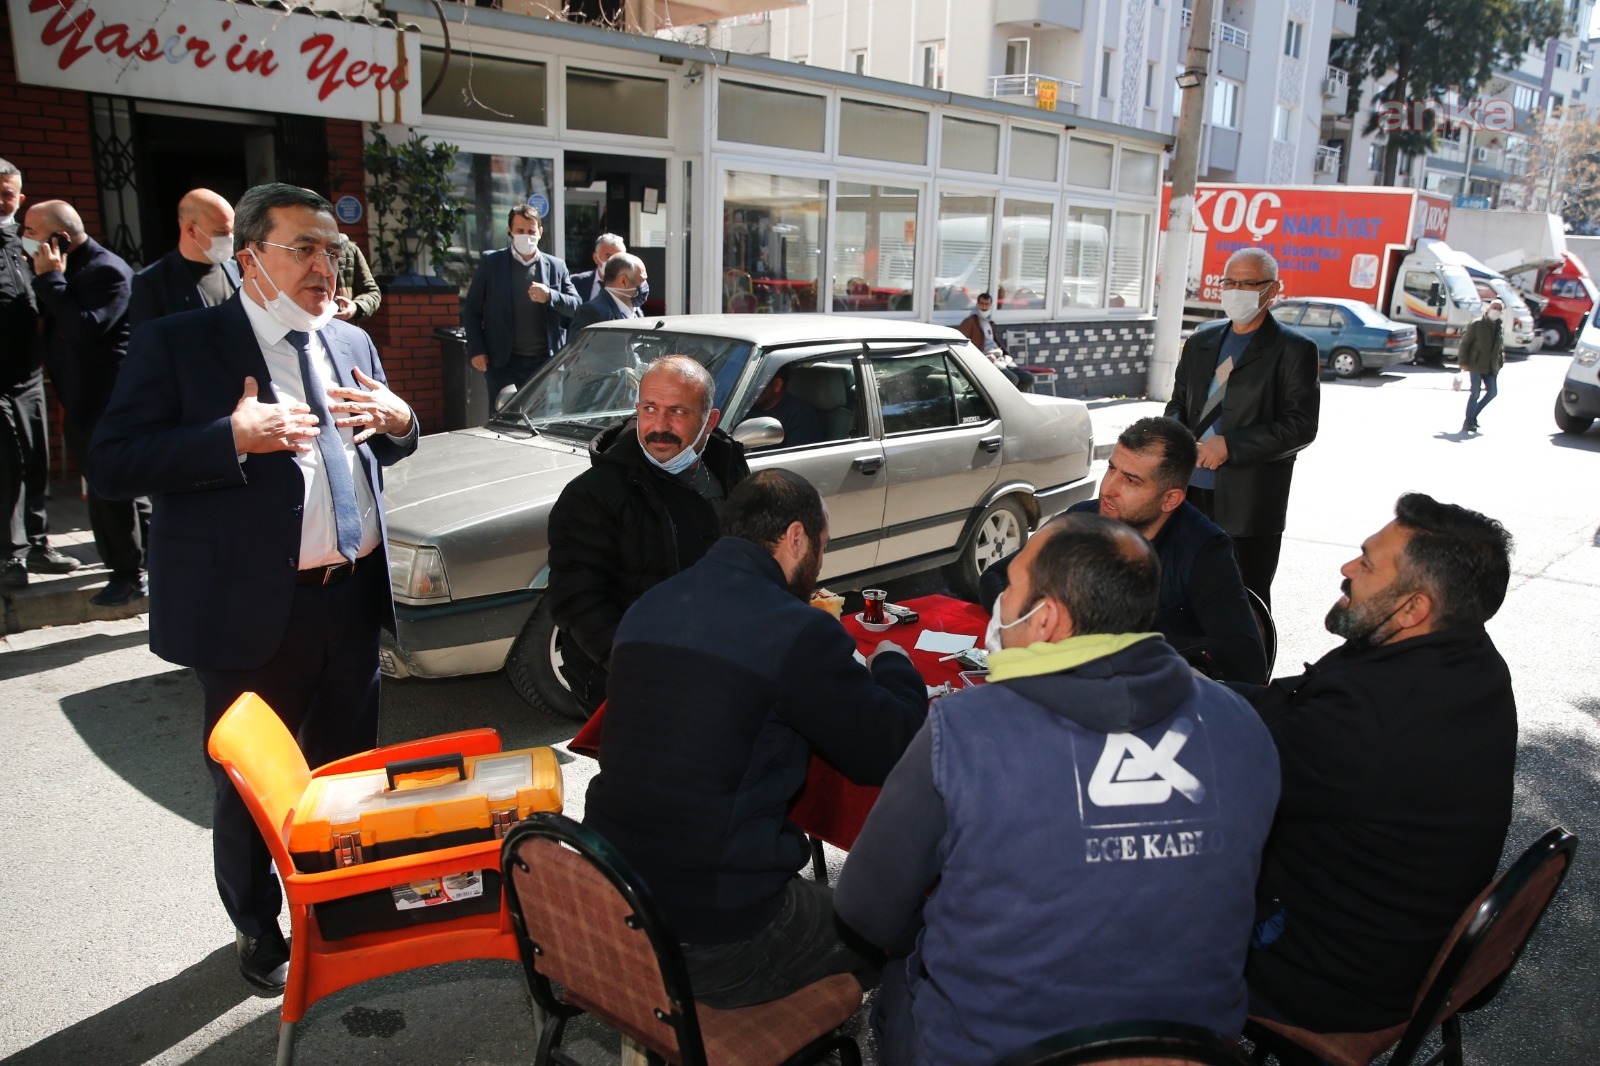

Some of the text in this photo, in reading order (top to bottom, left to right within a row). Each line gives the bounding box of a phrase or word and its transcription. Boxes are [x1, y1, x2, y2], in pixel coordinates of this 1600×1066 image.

[300, 32, 410, 101] Yeri
[1191, 190, 1281, 241] KOÇ
[1282, 210, 1384, 240] NAKLİYAT
[1085, 835, 1138, 863] EGE
